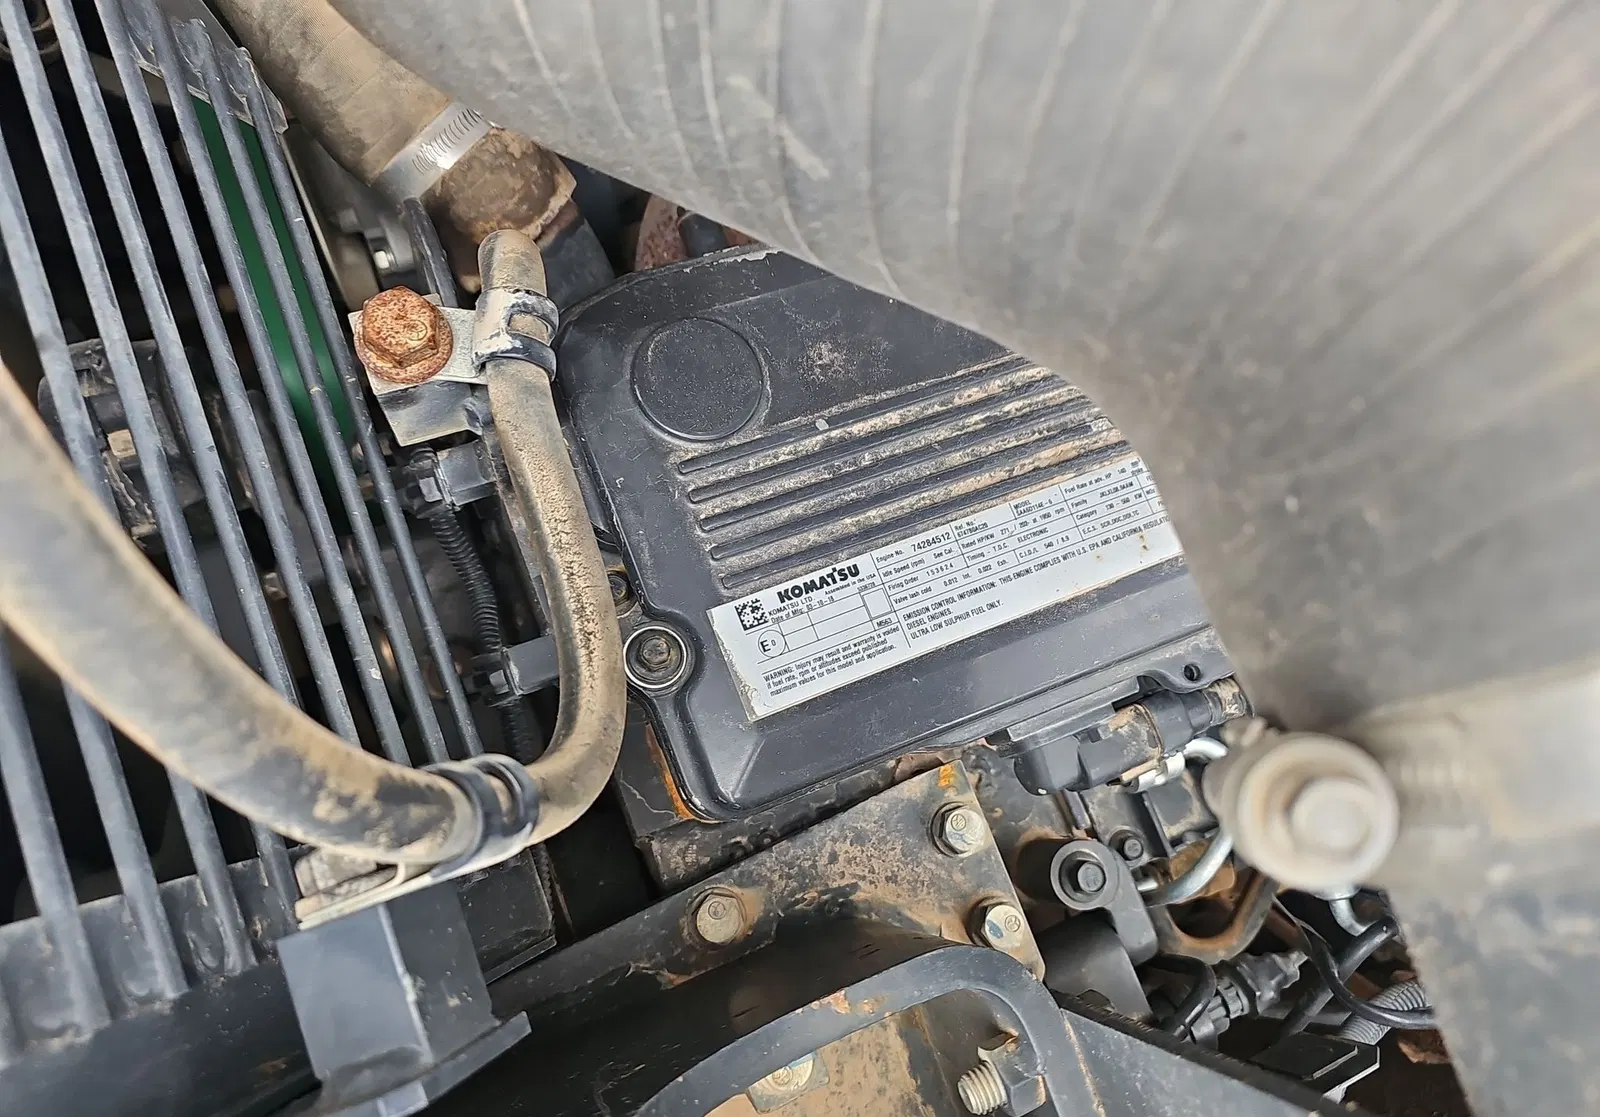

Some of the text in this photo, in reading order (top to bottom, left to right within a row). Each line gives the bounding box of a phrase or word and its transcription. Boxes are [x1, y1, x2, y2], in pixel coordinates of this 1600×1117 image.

[1064, 486, 1076, 494] Fuel
[1076, 482, 1088, 490] Rate
[1013, 500, 1032, 510] MODEL
[1071, 499, 1088, 509] Family
[1076, 509, 1097, 521] Category
[954, 523, 966, 531] Ref.
[961, 539, 977, 549] Rated
[1000, 527, 1010, 535] 271
[1054, 507, 1065, 515] rpm
[876, 553, 894, 563] Engine
[911, 532, 952, 552] 74284512
[967, 551, 985, 562] Timing
[992, 542, 1009, 552] T.D.C.
[1017, 527, 1049, 543] ELECTRONIC
[882, 570, 893, 578] Idle
[893, 563, 910, 574] Speed
[910, 558, 925, 568] (rpm)
[903, 606, 931, 621] EMISSION
[930, 596, 957, 611] CONTROL
[957, 581, 997, 601] INFORMATION:
[999, 575, 1013, 585] THIS
[1012, 567, 1033, 580] ENGINE
[1033, 556, 1061, 572] COMPLIES
[1061, 551, 1076, 561] WITH
[1076, 547, 1088, 556] U.S.
[1088, 542, 1100, 551] EPA
[1100, 537, 1112, 547] AND
[1112, 526, 1143, 542] CALIFORNIA
[776, 563, 860, 604] KOMATSU
[825, 582, 851, 595] Assembled
[887, 581, 904, 591] Firing
[904, 576, 919, 585] Order
[893, 596, 908, 604] Valve
[908, 591, 920, 599] lash
[920, 586, 932, 595] cold
[943, 577, 958, 587] 0.012
[768, 596, 816, 617] KOMATSU LTD.
[771, 615, 784, 623] Date
[906, 608, 954, 630] DIESEL ENGINES.
[910, 599, 1004, 640] ULTRA LOW SULPHUR FUEL ONLY.
[763, 666, 794, 682] WARNING:
[795, 660, 812, 670] Injury
[812, 655, 824, 664] may
[825, 648, 841, 658] result
[841, 644, 852, 652] and
[852, 635, 876, 648] warranty
[882, 626, 900, 636] voided
[772, 678, 784, 687] fuel
[784, 673, 798, 683] rate,
[798, 669, 810, 677] rpm
[818, 656, 841, 669] altitudes
[842, 648, 861, 660] exceed
[861, 638, 888, 653] published
[770, 682, 798, 697] maximum
[798, 675, 816, 686] values
[825, 667, 837, 675] this
[837, 659, 854, 670] model
[854, 655, 865, 664] and
[866, 644, 897, 659] application.
